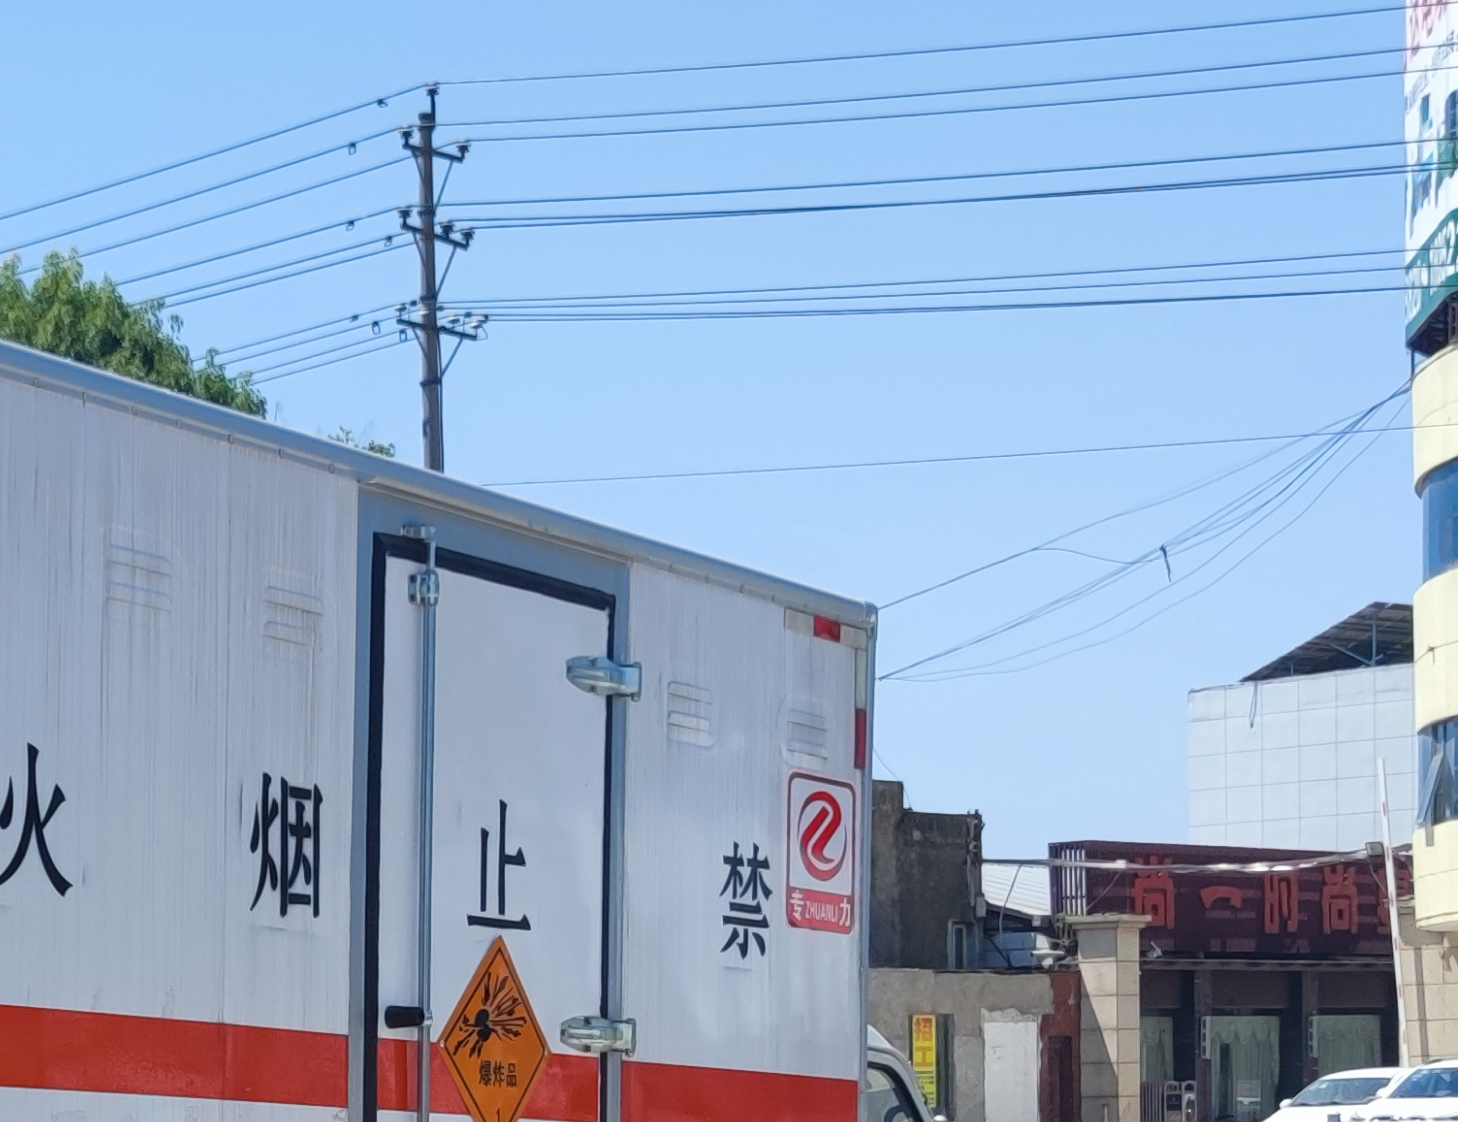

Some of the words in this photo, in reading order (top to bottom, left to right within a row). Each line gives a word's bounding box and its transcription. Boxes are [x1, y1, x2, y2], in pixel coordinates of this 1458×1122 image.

[249, 772, 323, 918] 烟
[466, 800, 532, 931] 止
[719, 840, 774, 960] 禁
[789, 890, 805, 921] 专
[804, 901, 839, 923] ZHUANLI
[838, 898, 851, 927] 力
[478, 1059, 518, 1088] 爆炸品
